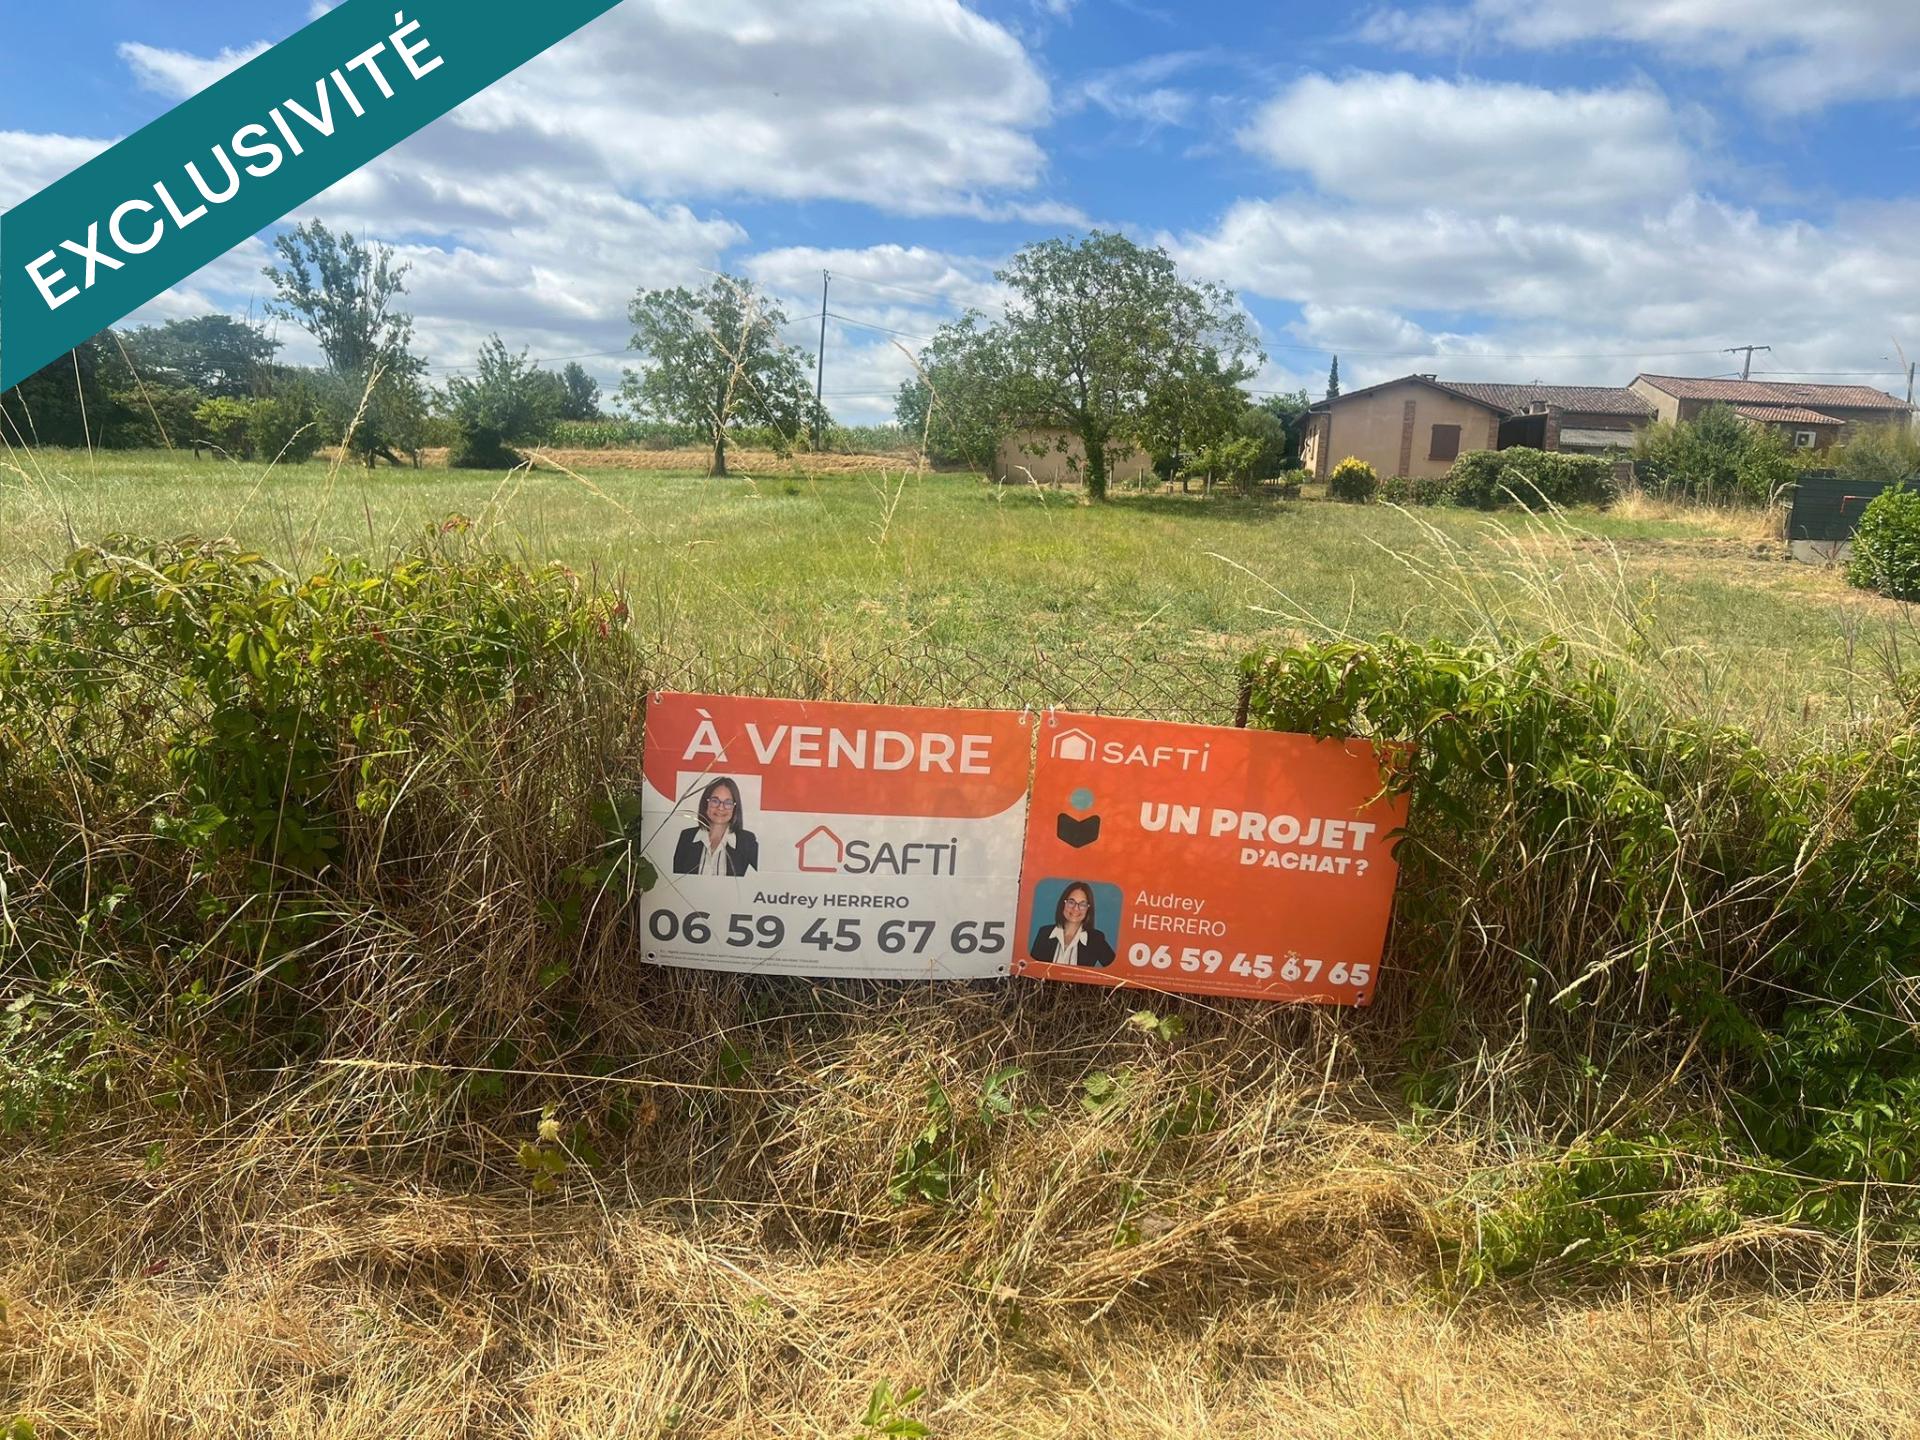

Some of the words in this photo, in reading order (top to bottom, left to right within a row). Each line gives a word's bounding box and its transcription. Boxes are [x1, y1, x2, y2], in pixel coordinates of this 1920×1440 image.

[682, 708, 728, 762] À
[745, 723, 992, 775] VENDRE
[1140, 802, 1200, 836] UN
[1210, 809, 1376, 851] PROJET
[753, 891, 818, 909] Audrey
[823, 893, 910, 909] HERRERO
[1135, 890, 1205, 913] Audrey
[649, 909, 711, 944] 06
[726, 914, 785, 949] 59
[801, 918, 861, 953] 45
[877, 920, 936, 954] 67
[950, 921, 1005, 954] 65
[1133, 914, 1226, 937] HERRERO
[1128, 943, 1172, 970] 06
[1180, 948, 1223, 974] 59
[1229, 953, 1273, 979] 45
[1280, 958, 1323, 982] 67
[1328, 962, 1371, 986] 65
